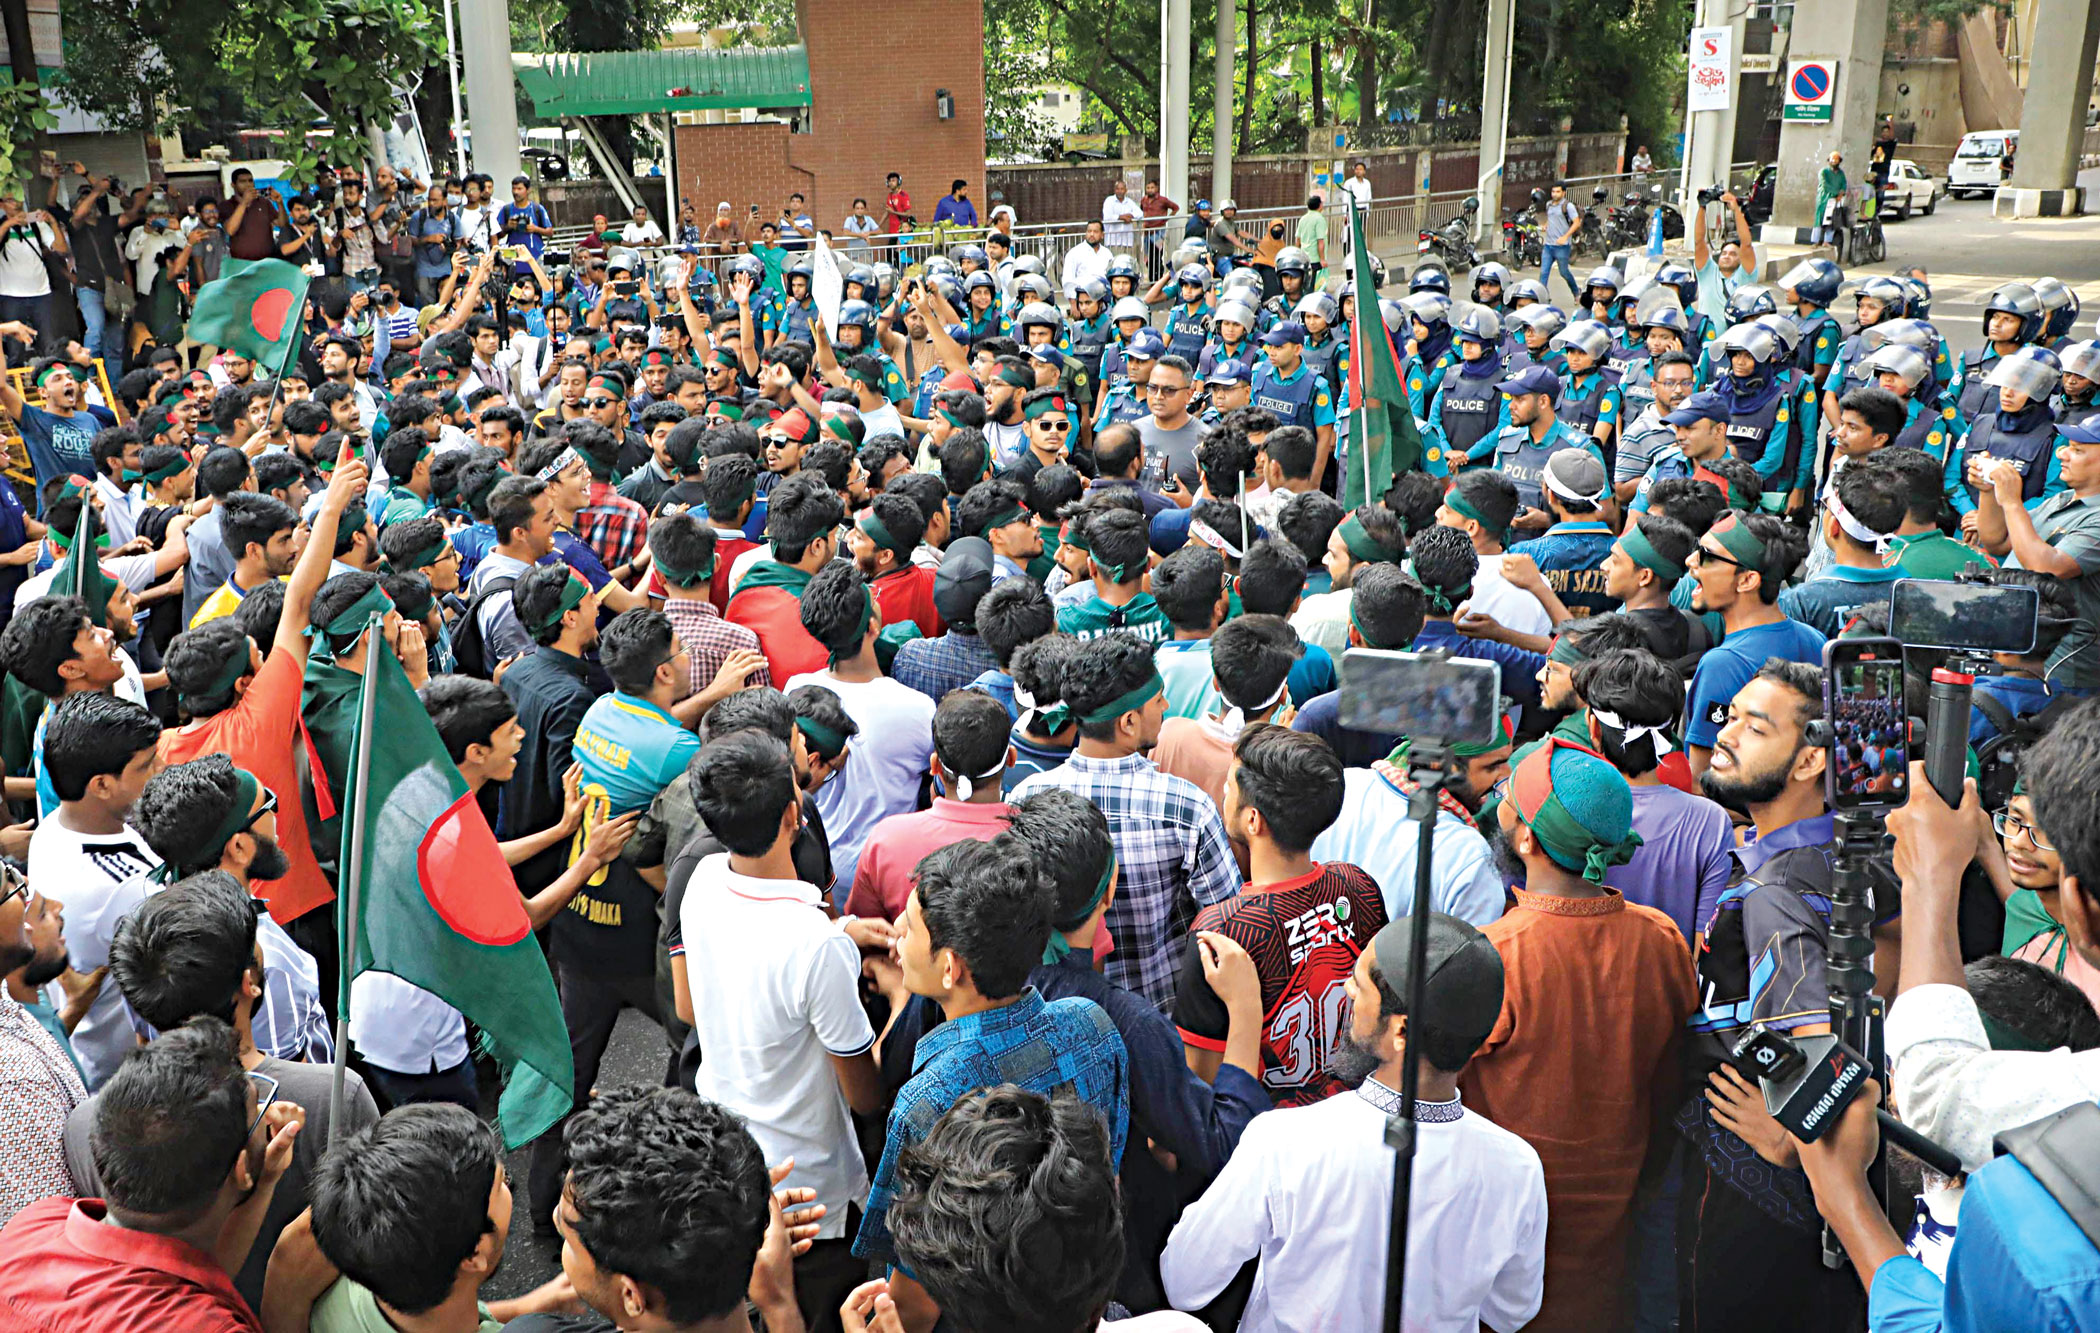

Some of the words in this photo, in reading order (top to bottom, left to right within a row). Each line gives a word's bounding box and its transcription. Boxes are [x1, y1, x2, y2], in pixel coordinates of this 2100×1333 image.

[1703, 38, 1717, 56] S
[1173, 322, 1205, 336] POLICE
[1261, 399, 1289, 412] POLICE
[1446, 399, 1484, 411] POLICE
[1503, 463, 1545, 480] POLIC
[588, 898, 622, 926] DHAKA
